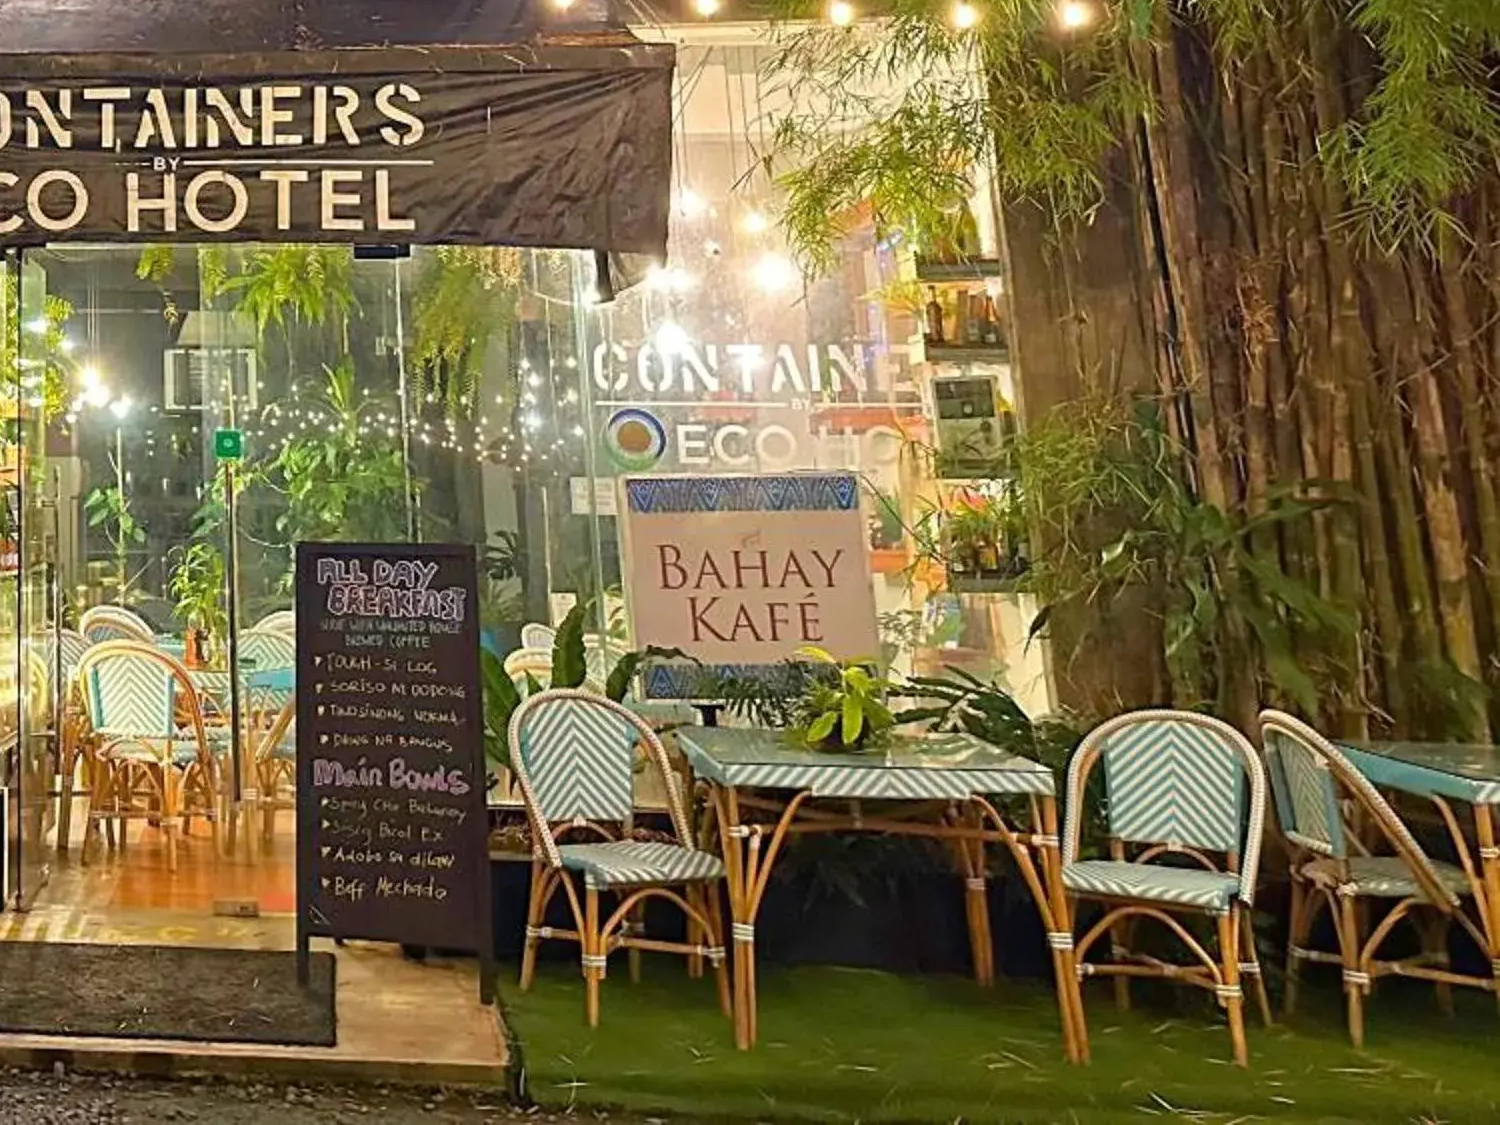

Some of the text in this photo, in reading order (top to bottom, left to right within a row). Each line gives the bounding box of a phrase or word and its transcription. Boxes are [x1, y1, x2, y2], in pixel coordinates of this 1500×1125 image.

[153, 155, 182, 172] BY
[126, 169, 418, 234] HOTEL
[677, 424, 797, 466] ECO
[316, 557, 440, 592] ALL DAY
[656, 543, 847, 592] BAHAY
[327, 584, 468, 622] BREAKFAST
[686, 591, 825, 644] KAFÉ
[312, 756, 471, 796] Main Bowls
